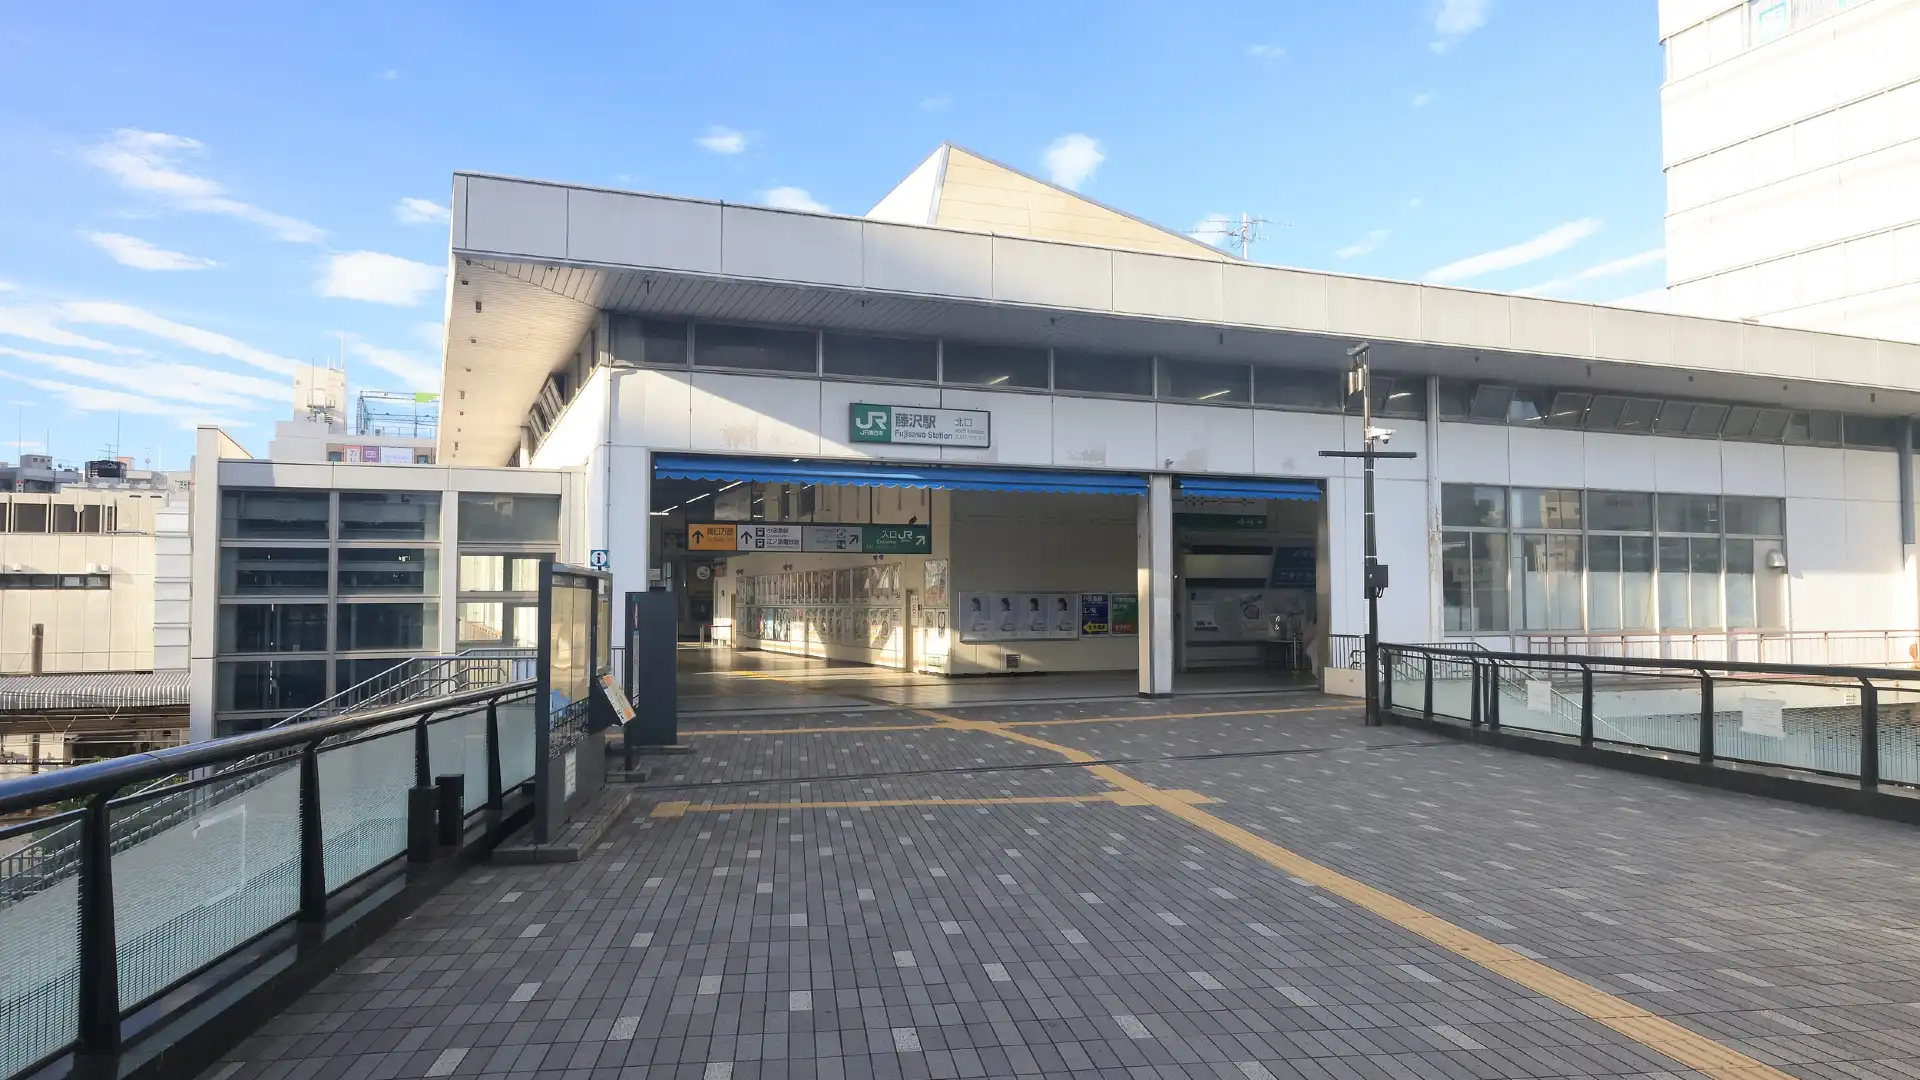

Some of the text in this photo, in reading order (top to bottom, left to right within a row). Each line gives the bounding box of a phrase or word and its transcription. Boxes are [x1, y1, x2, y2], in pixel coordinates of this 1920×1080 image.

[856, 411, 887, 429] JR
[894, 412, 936, 429] 藤沢駅
[954, 417, 973, 427] 北口
[894, 429, 927, 439] Fujisawa
[927, 431, 953, 440] Station
[881, 530, 913, 539] 入口 JR
